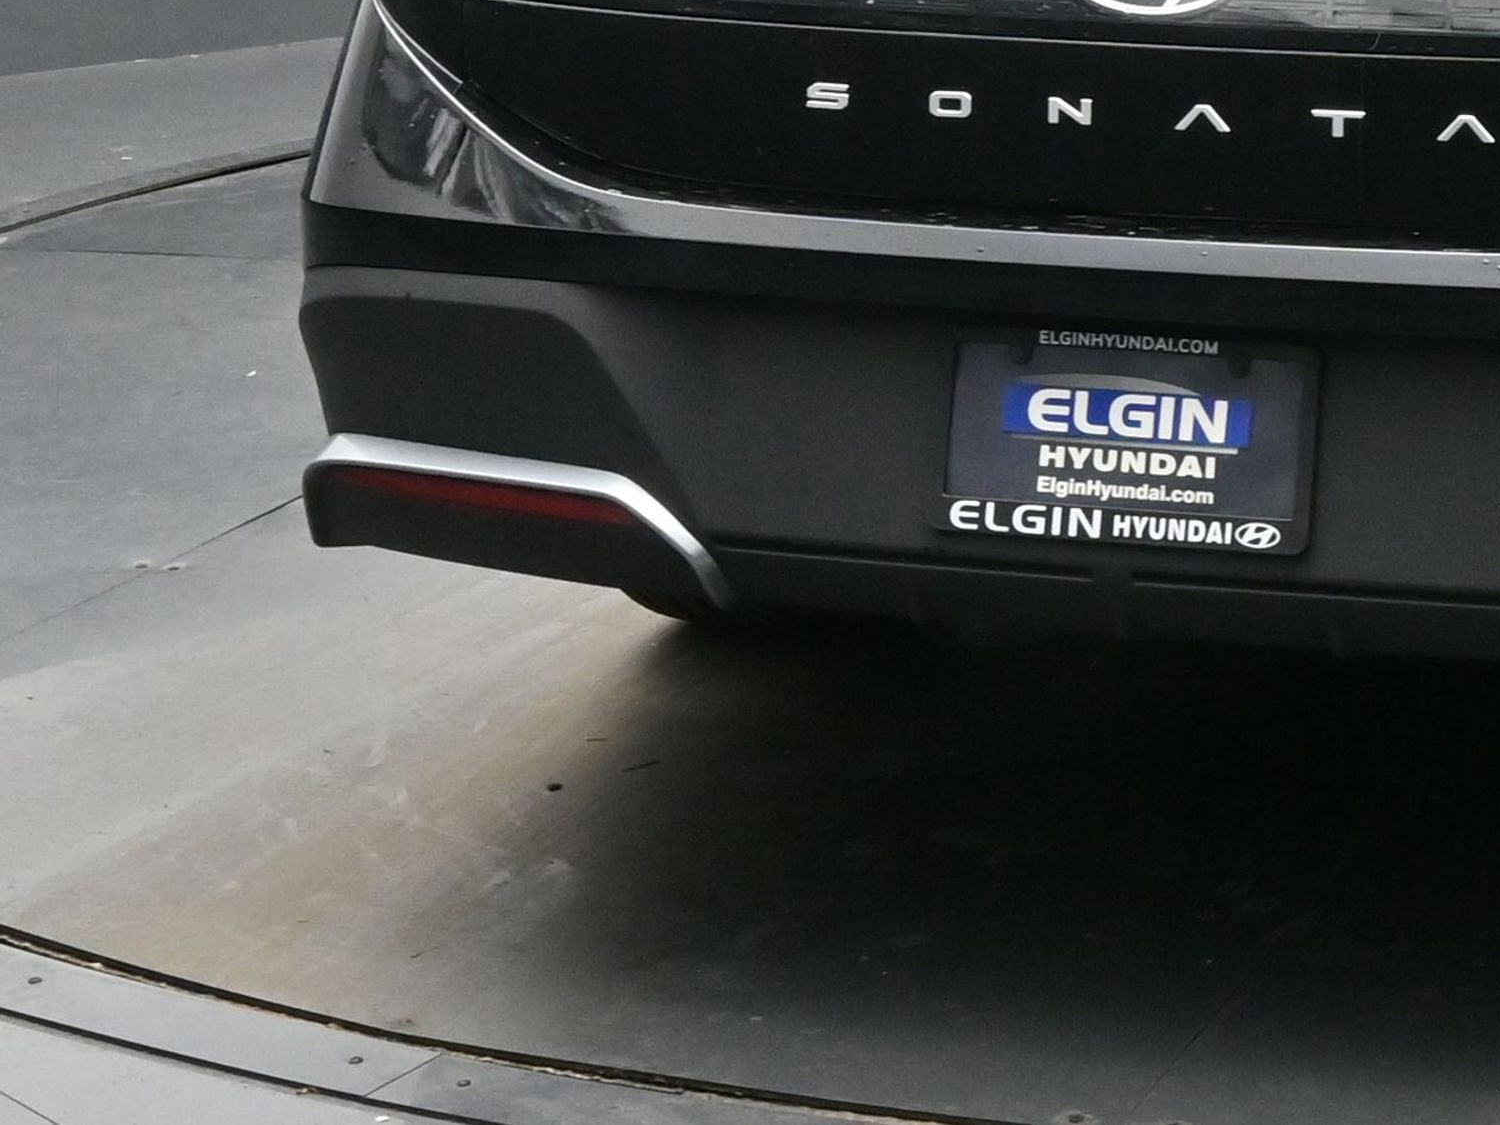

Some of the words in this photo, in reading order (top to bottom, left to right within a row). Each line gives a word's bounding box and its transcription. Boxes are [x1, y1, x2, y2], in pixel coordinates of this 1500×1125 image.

[1038, 329, 1220, 355] ELGINHYUNDAI.COM
[1027, 387, 1230, 444] ELGIN
[1038, 443, 1216, 480] HYUNDAI
[1036, 475, 1215, 505] ElginHyundai.com
[949, 500, 1103, 539] ELGIN
[1112, 514, 1233, 545] HYUNDAI
